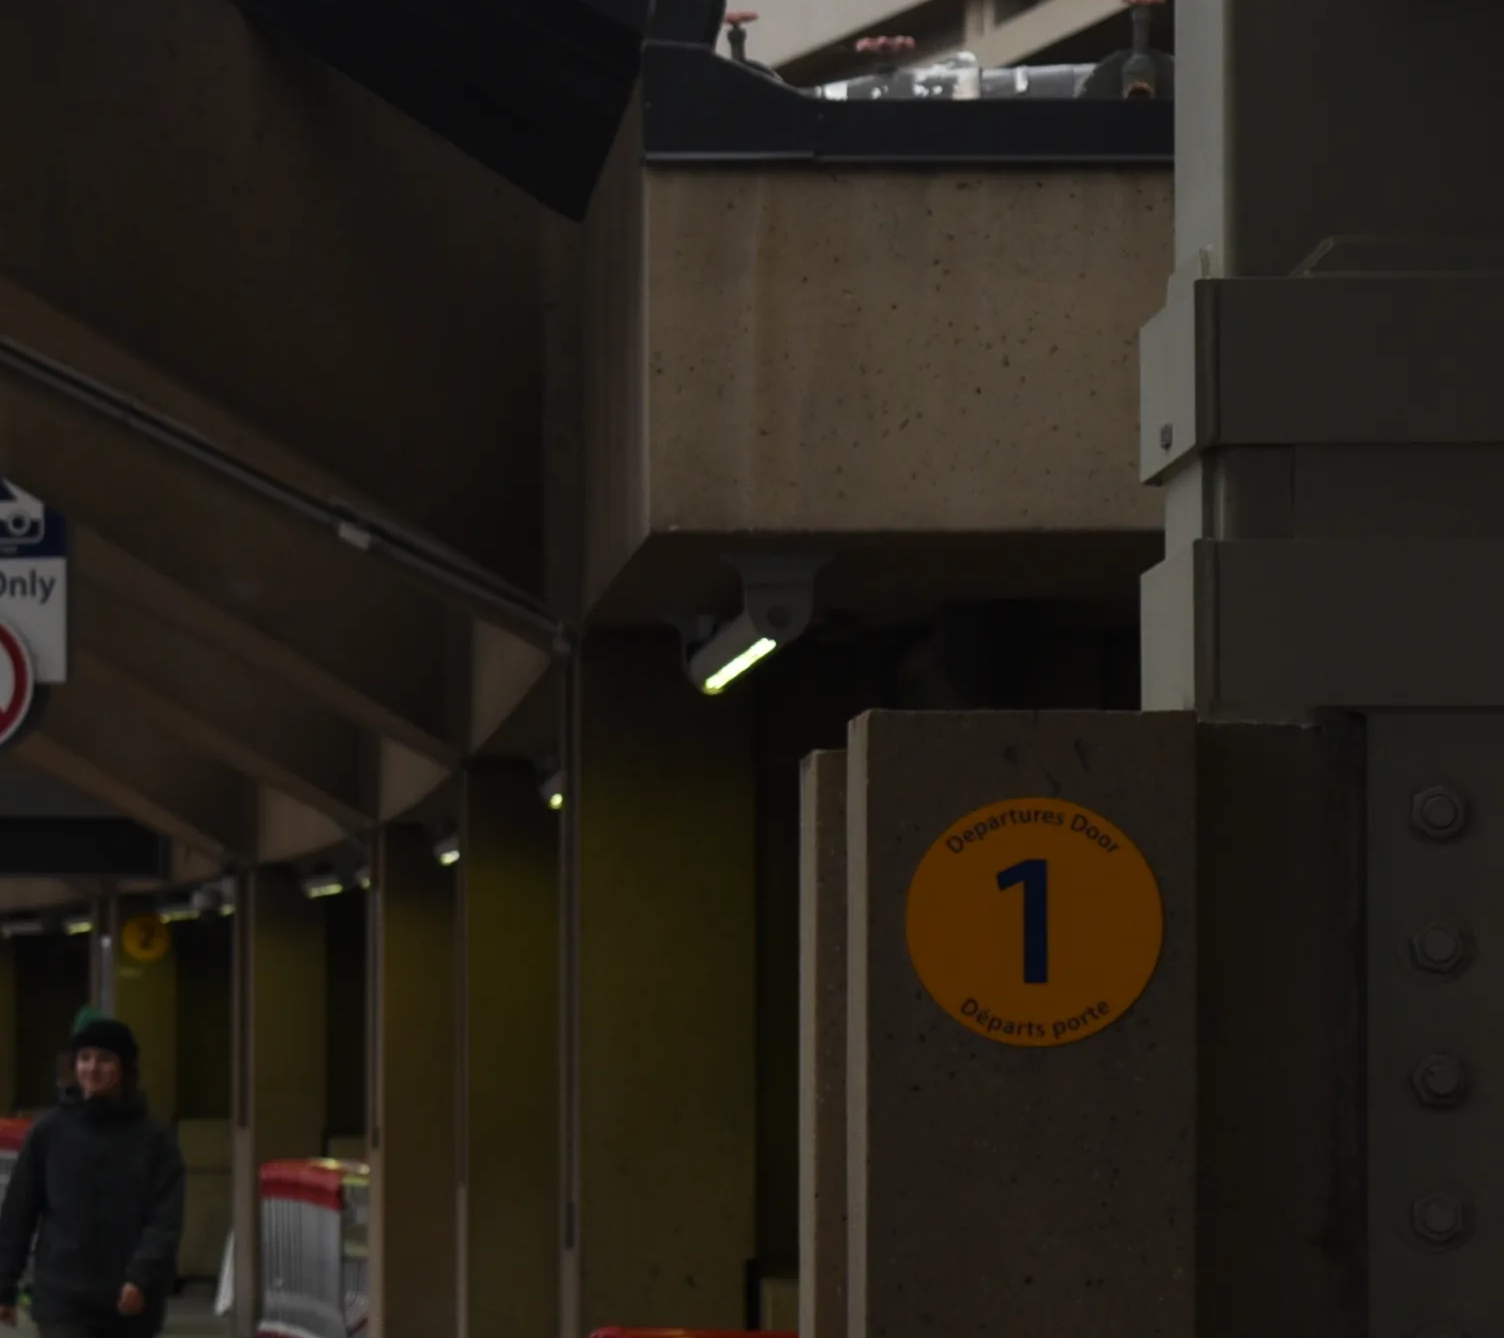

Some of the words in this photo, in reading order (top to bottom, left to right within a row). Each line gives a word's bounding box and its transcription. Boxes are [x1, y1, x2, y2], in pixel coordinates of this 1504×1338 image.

[945, 809, 1065, 855] Departures
[1070, 813, 1121, 854] Door
[996, 858, 1048, 984] 1
[960, 998, 1046, 1037] Départs
[1052, 999, 1110, 1039] porte
